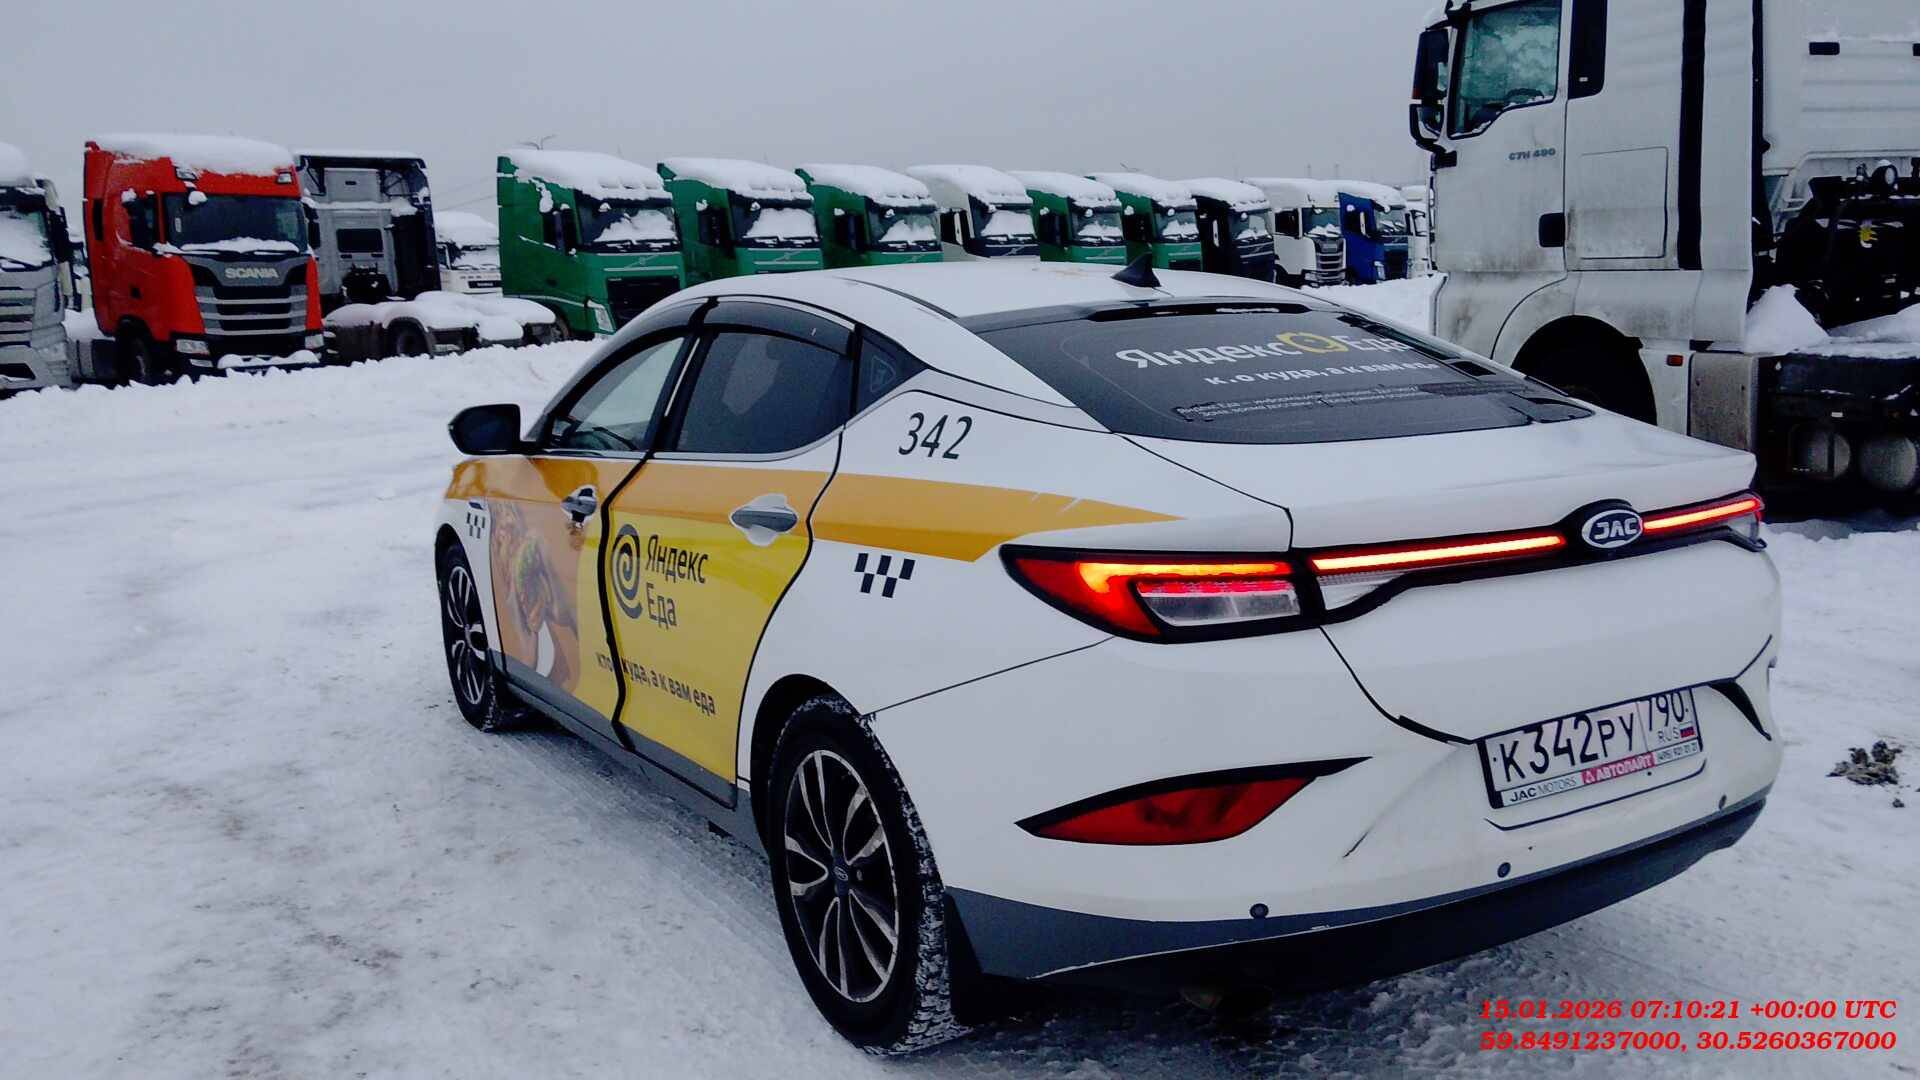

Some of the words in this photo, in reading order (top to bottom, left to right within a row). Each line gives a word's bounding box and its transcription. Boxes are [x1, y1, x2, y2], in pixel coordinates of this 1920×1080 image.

[225, 267, 279, 279] SCANIA
[1115, 342, 1303, 369] Яндекс
[1204, 374, 1256, 385] ко
[898, 412, 973, 460] 342
[1594, 517, 1638, 540] JAC
[645, 534, 709, 584] Яндекс
[646, 582, 677, 630] Еда
[650, 670, 660, 688] а
[658, 673, 669, 693] к
[668, 678, 692, 703] вам
[693, 688, 717, 717] еда
[1657, 726, 1680, 742] RUS
[1510, 787, 1537, 802] JAC
